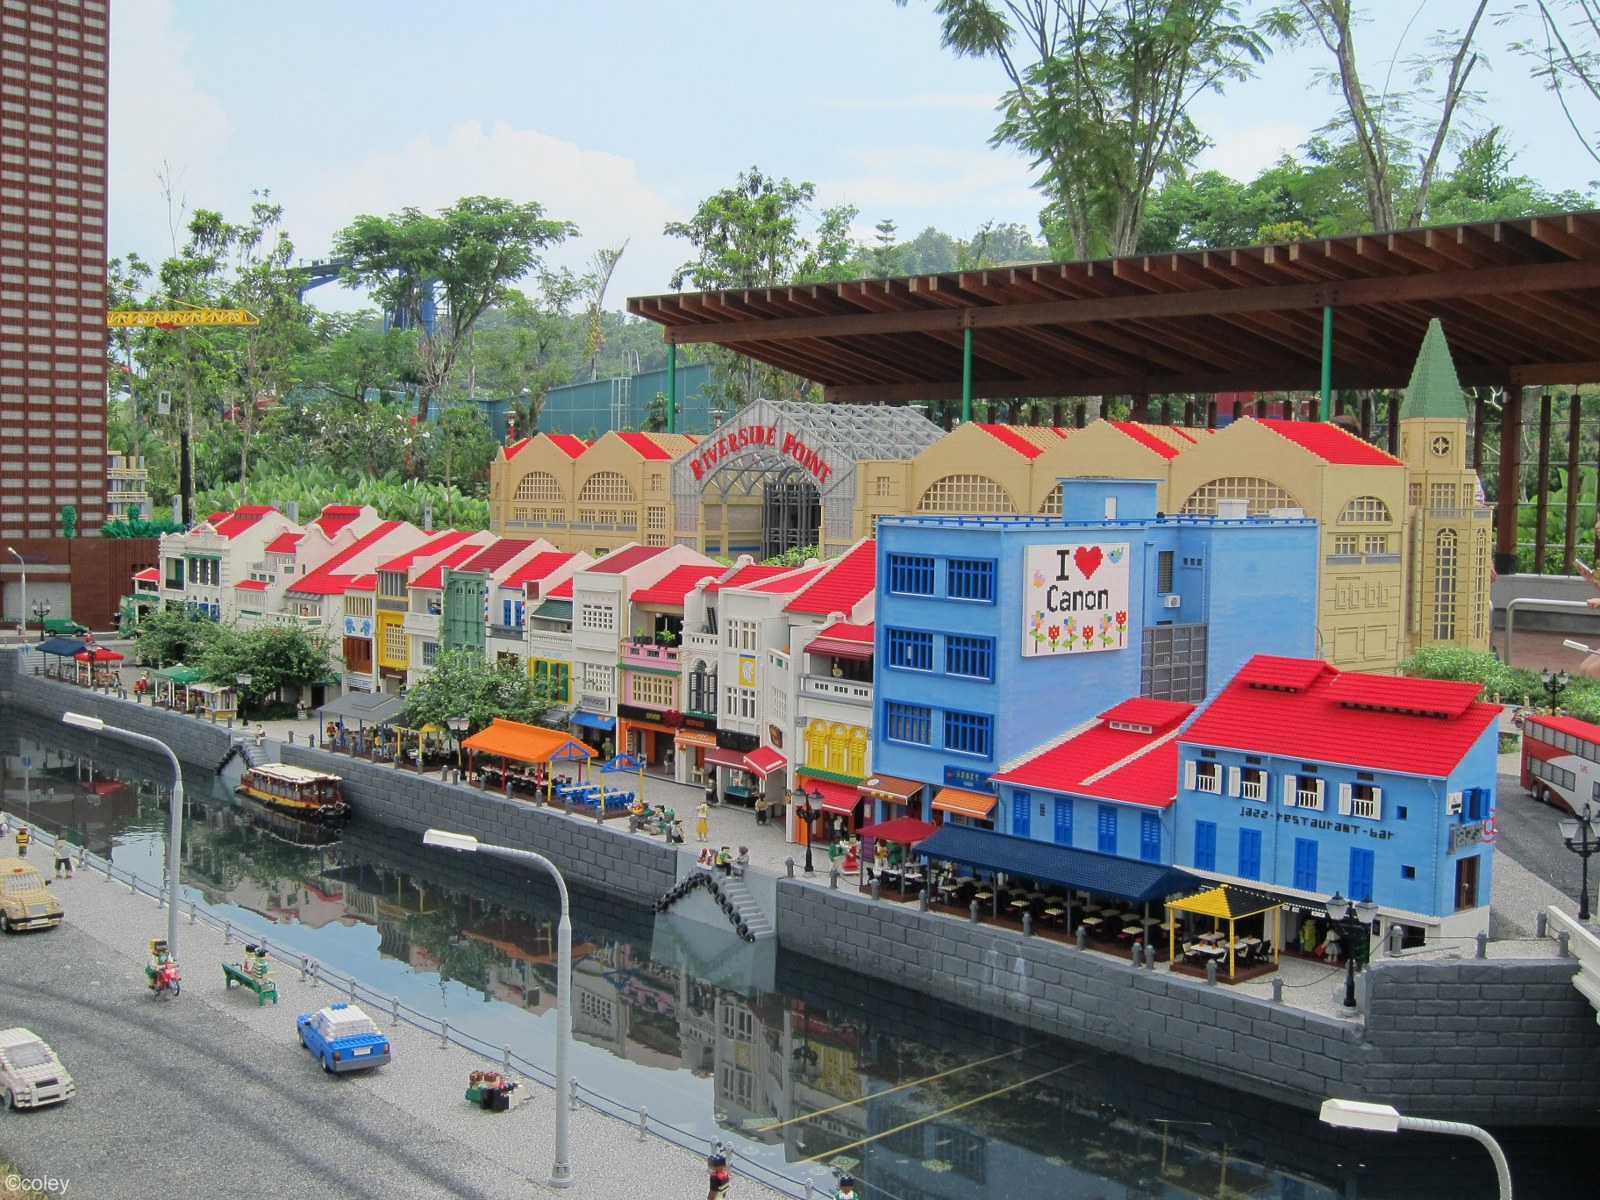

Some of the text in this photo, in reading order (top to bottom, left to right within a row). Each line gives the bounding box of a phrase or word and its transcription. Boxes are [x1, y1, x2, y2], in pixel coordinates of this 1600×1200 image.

[689, 425, 832, 484] RIVERSIDE POINT
[1055, 549, 1070, 581] I
[1046, 584, 1109, 612] Canon
